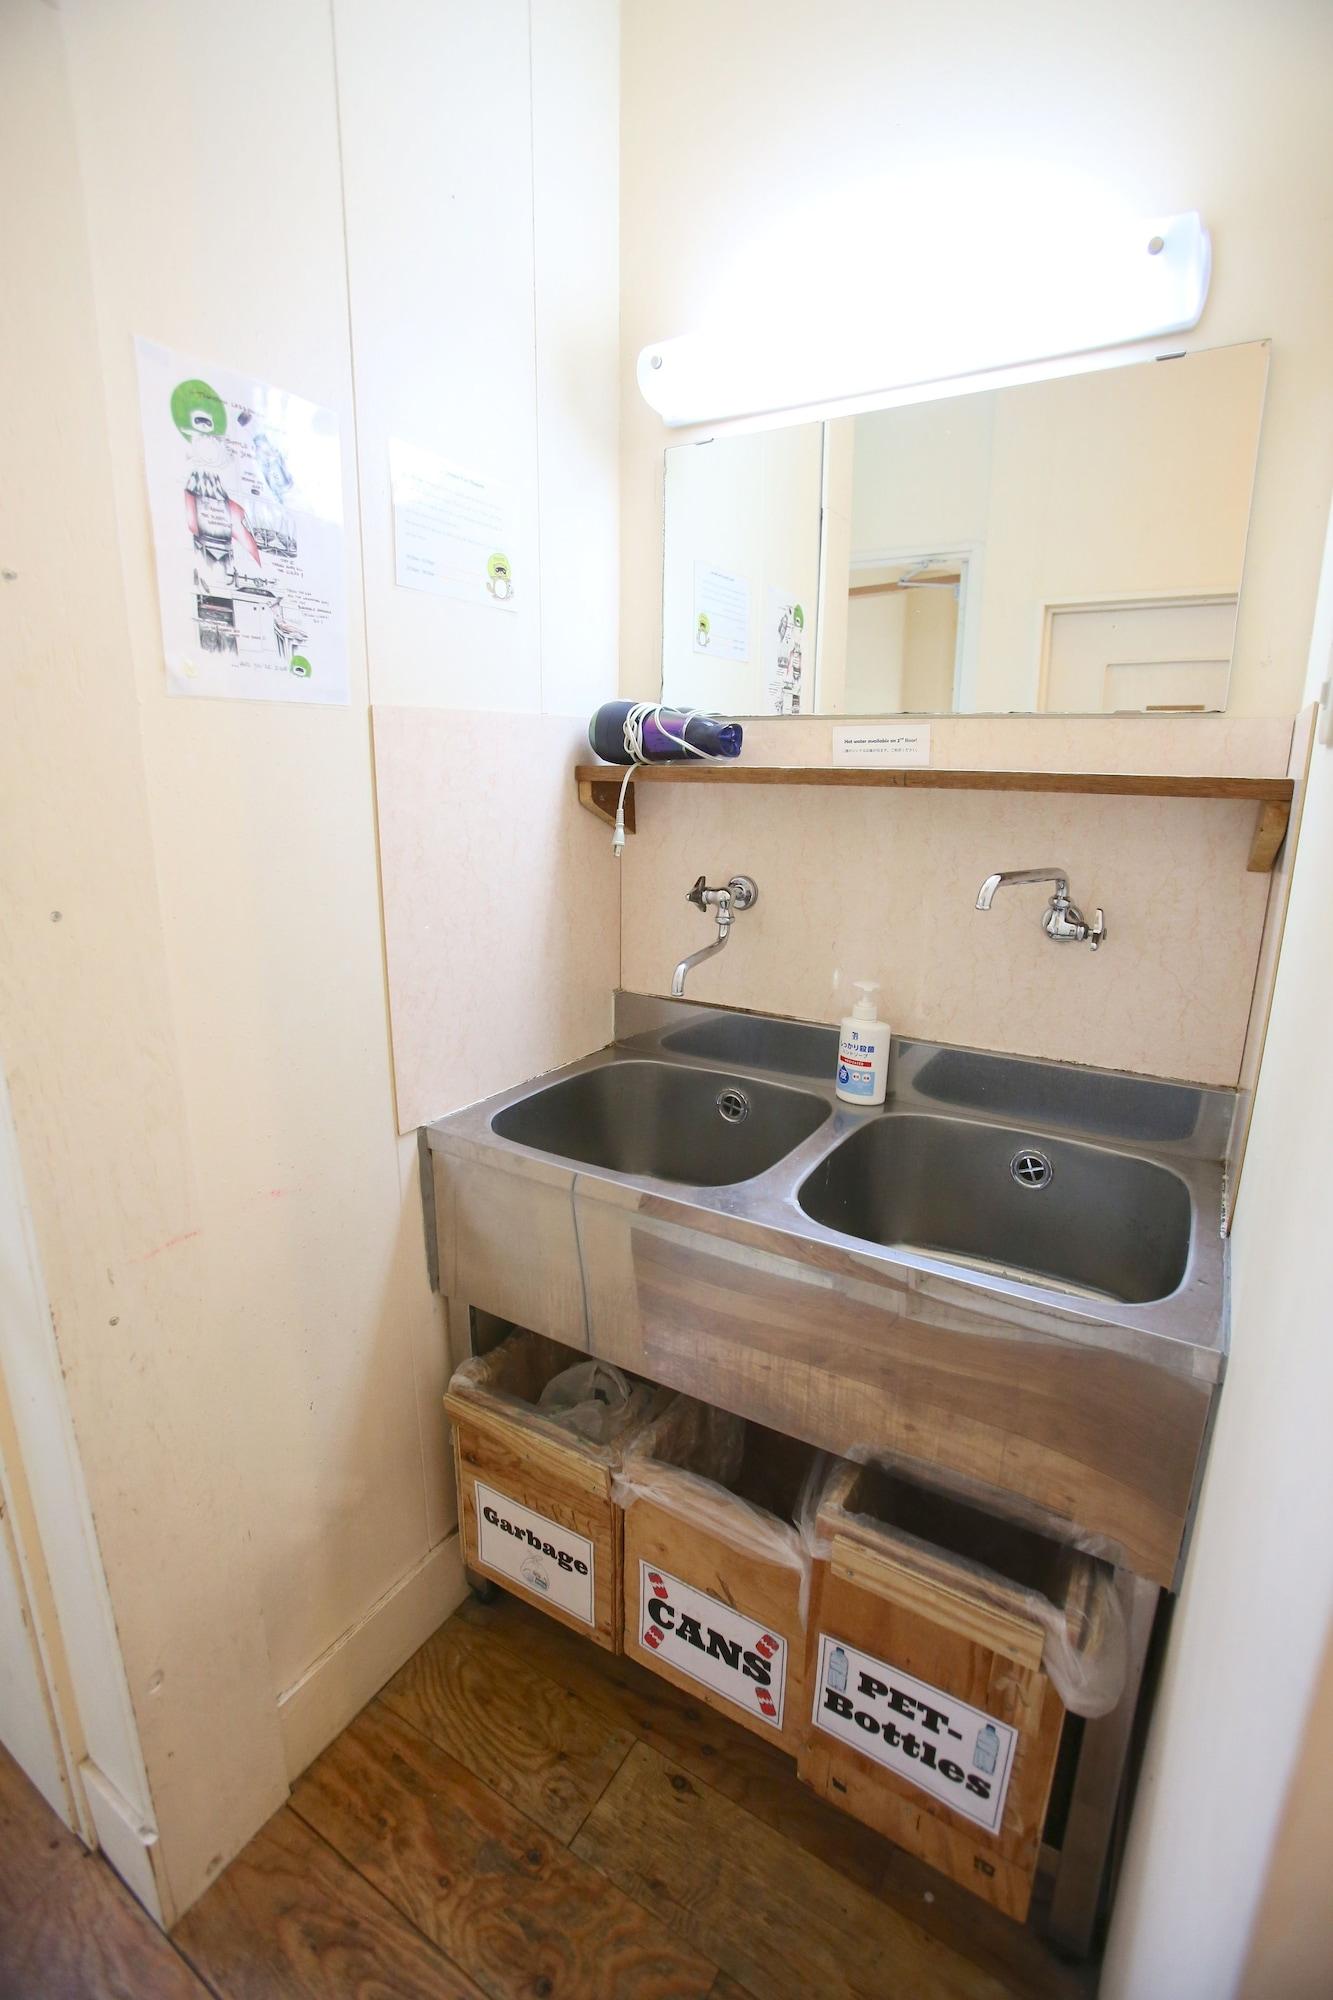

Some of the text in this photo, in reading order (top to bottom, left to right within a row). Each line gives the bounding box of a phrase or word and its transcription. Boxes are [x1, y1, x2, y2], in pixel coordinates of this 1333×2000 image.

[483, 1506, 589, 1576] Garbage
[647, 1598, 771, 1686] CANS
[823, 1687, 991, 1800] Bottles
[857, 1671, 963, 1740] PET-
